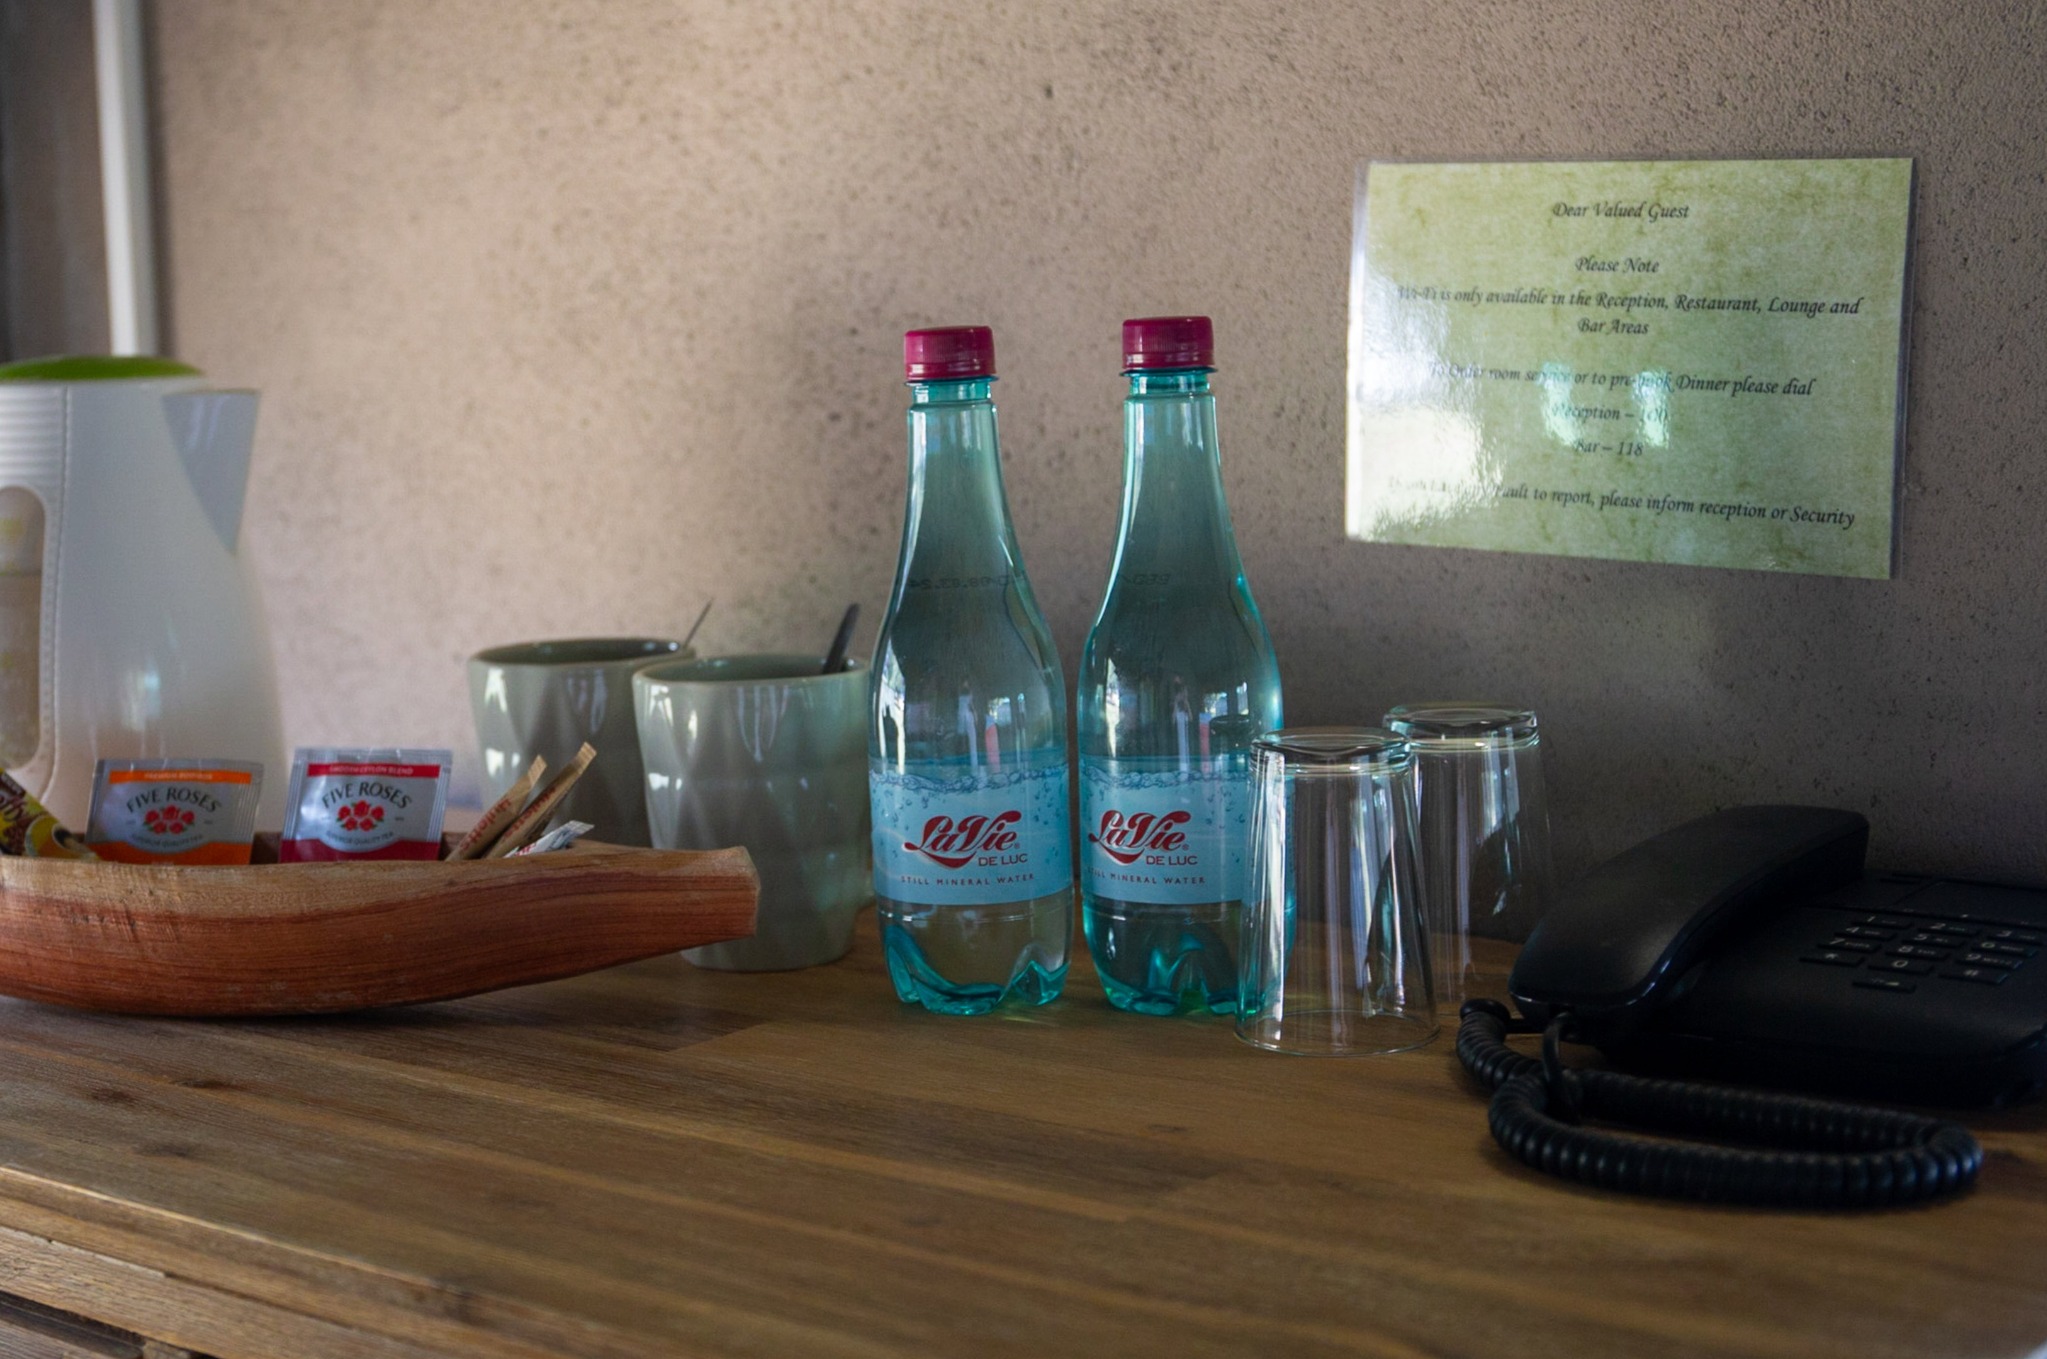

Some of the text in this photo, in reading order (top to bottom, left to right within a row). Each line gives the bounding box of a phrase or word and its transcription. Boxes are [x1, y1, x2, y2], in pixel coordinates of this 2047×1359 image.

[1552, 200, 1690, 223] Dear Valued Guest
[1575, 256, 1660, 273] Please Note
[1440, 287, 1453, 301] is
[1454, 285, 1483, 308] only
[1485, 286, 1548, 305] available
[1551, 289, 1566, 305] in
[1568, 289, 1592, 306] the
[1593, 291, 1669, 312] Reception,
[1674, 293, 1762, 314] Restaurant,
[1766, 297, 1827, 318] Lounge
[1829, 296, 1865, 315] and
[1577, 317, 1649, 335] Bar Areas
[1488, 368, 1520, 381] room
[1574, 372, 1590, 385] or
[1591, 370, 1606, 385] to
[1675, 374, 1731, 392] Dinner
[1731, 376, 1779, 397] please
[1781, 376, 1817, 396] dial
[1617, 440, 1644, 456] 118
[1533, 486, 1547, 501] to
[1551, 489, 1595, 508] report,
[1599, 489, 1643, 510] please
[1646, 493, 1694, 515] inform
[1699, 500, 1766, 520] reception
[1771, 507, 1789, 520] or
[1789, 505, 1855, 530] Security
[126, 786, 222, 814] FIVE ROSES
[322, 780, 413, 809] FIVE ROSES
[977, 852, 1029, 867] DE LUC
[1146, 855, 1199, 866] DE LUC
[900, 872, 1035, 887] STILL MINERAL WATER
[1110, 872, 1158, 885] MINERAL
[1163, 876, 1206, 885] WATER
